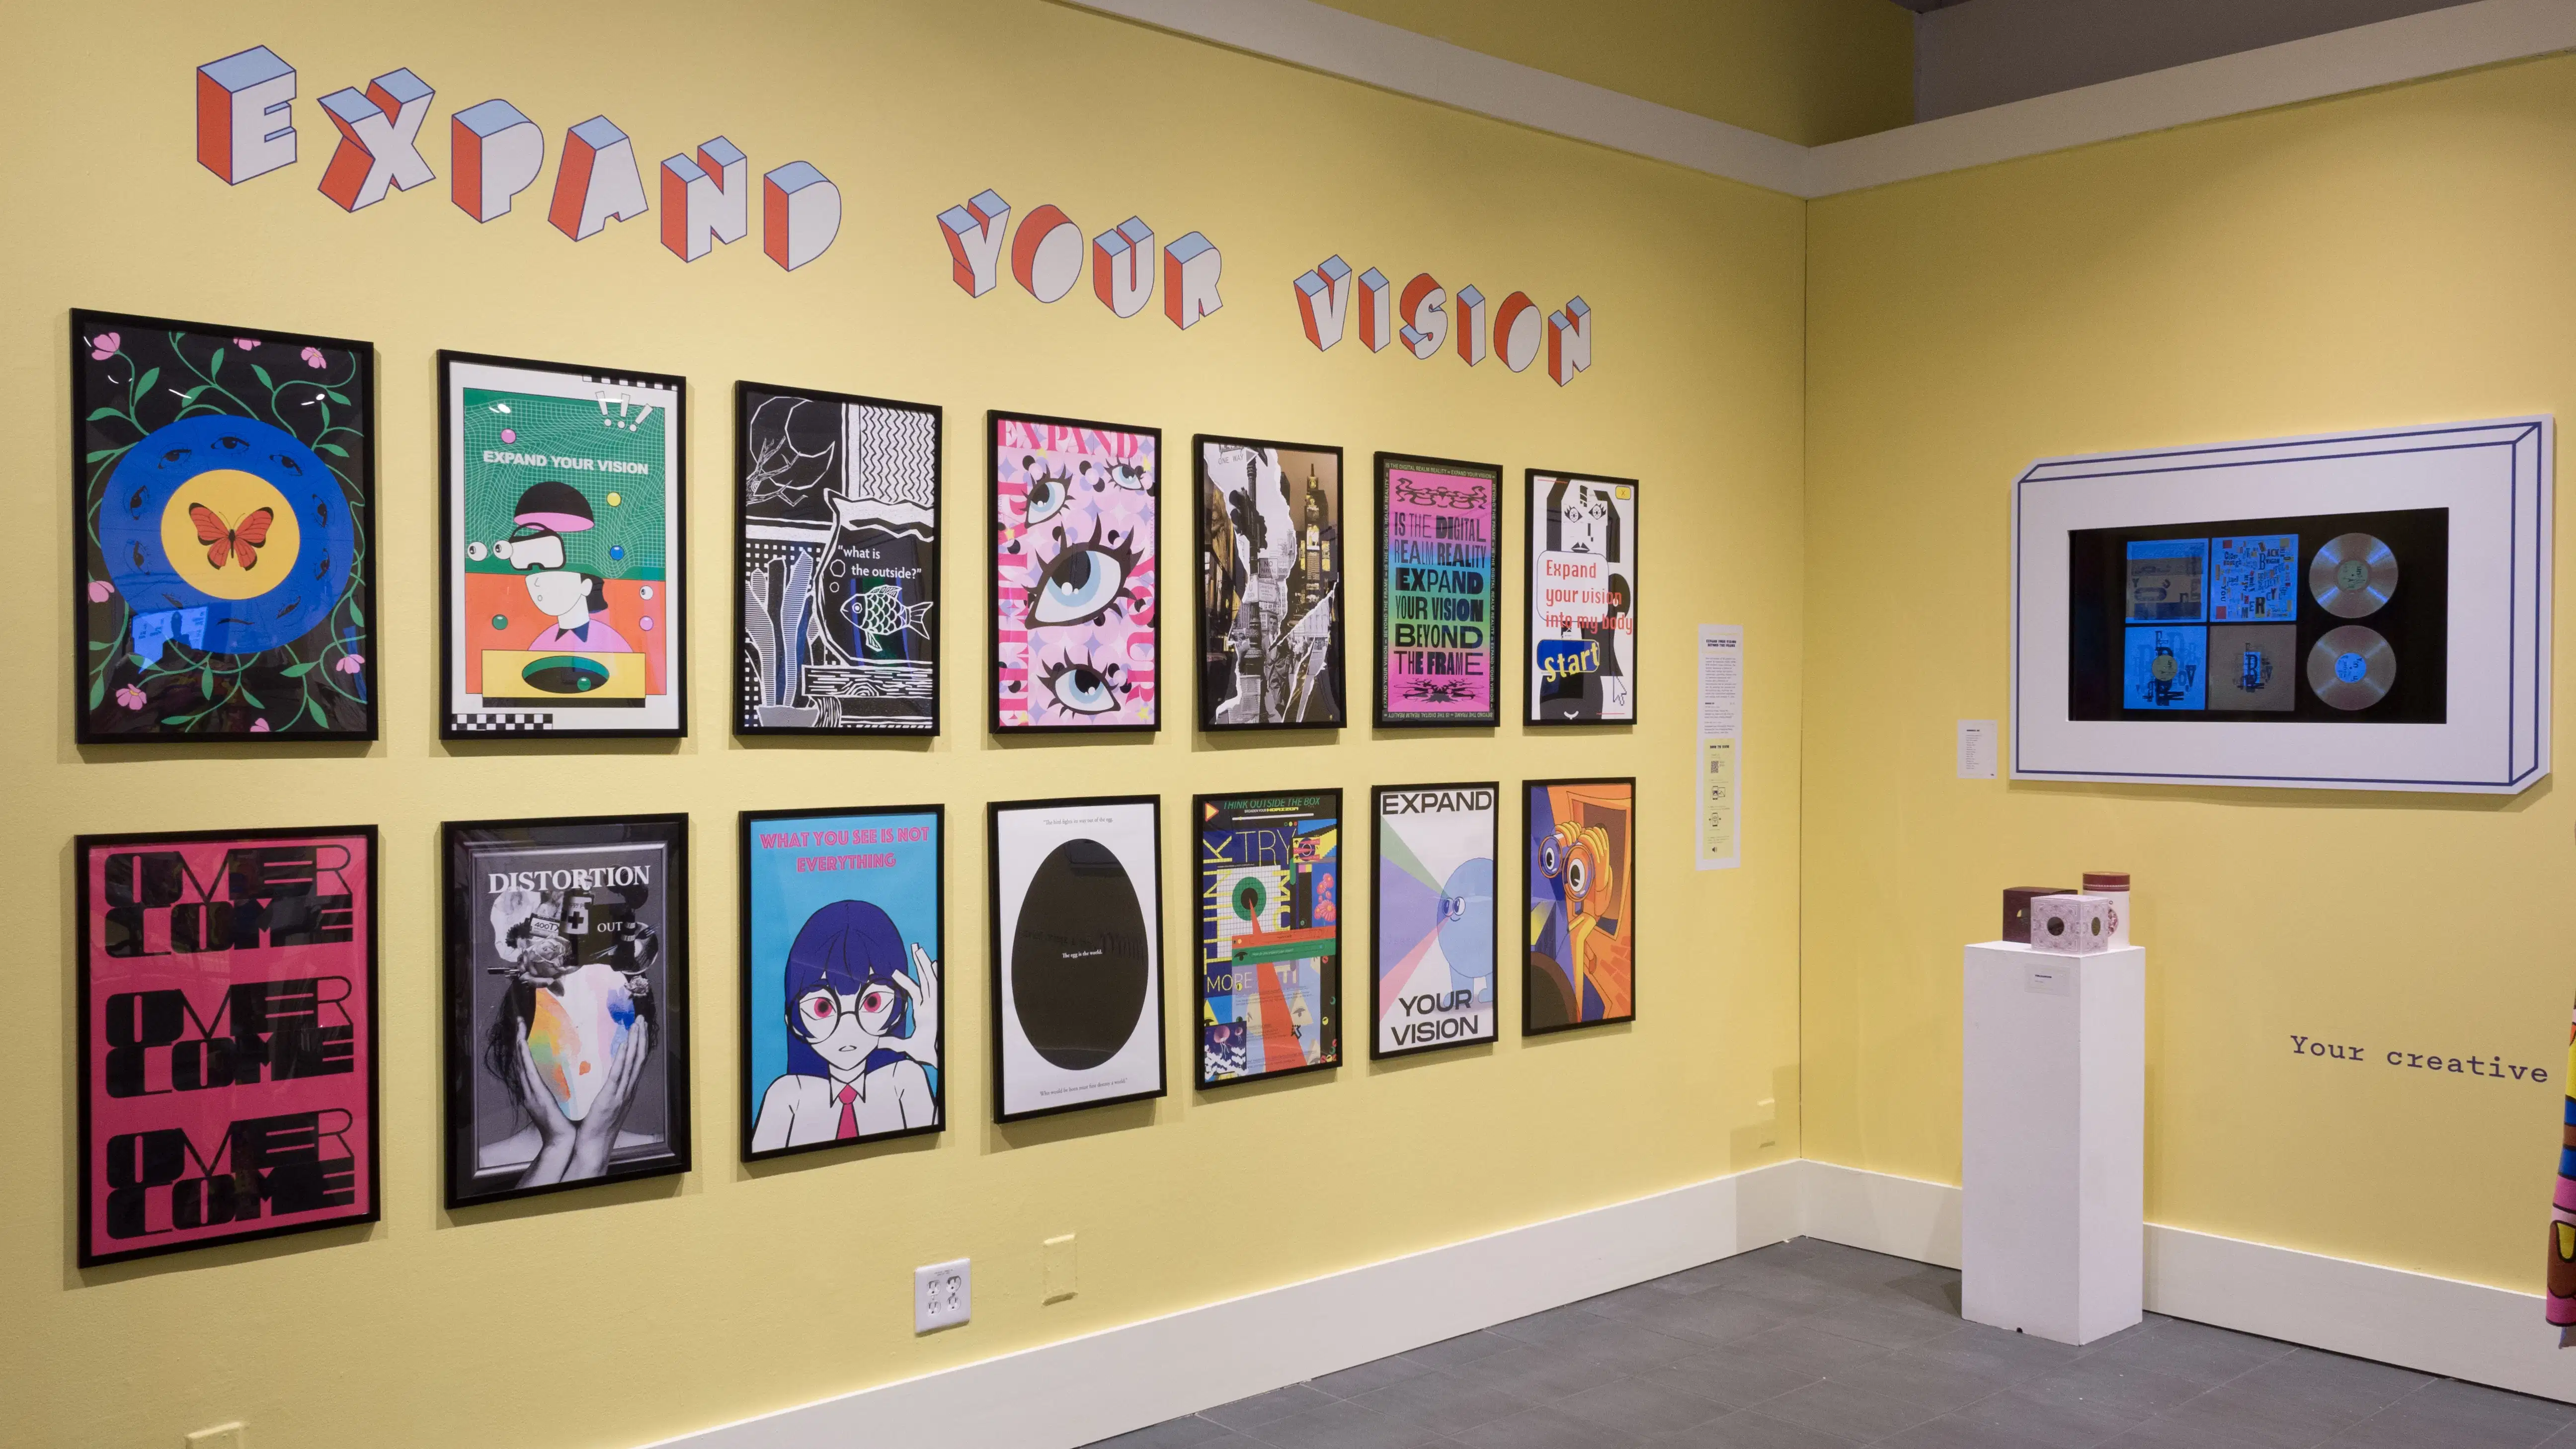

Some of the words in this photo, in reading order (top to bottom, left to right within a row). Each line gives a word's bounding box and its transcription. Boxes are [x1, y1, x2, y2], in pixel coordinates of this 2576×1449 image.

[197, 45, 841, 271] EXPAND
[937, 188, 1223, 330] YOUR
[1293, 254, 1591, 387] VISION
[998, 419, 1138, 458] EXPAND
[483, 451, 547, 467] EXPAND
[551, 456, 594, 471] YOUR
[597, 460, 648, 475] VISION
[1394, 512, 1406, 537] IS
[1409, 513, 1432, 538] THE
[1436, 515, 1486, 542] DIGITAL
[838, 545, 870, 559] "what
[872, 549, 881, 560] is
[1394, 539, 1434, 565] REALM
[1437, 542, 1486, 568] REALITY
[851, 564, 870, 576] the
[872, 568, 922, 579] outside?"
[1395, 567, 1484, 594] EXPAND
[1546, 560, 1597, 580] Expand
[1395, 595, 1428, 620] YOUR
[1432, 597, 1484, 622] VISION
[1546, 588, 1579, 607] your
[1582, 588, 1622, 605] vision
[1126, 555, 1154, 705] YOUR
[1395, 623, 1483, 649] BEYOND
[1546, 611, 1573, 629] into
[1577, 616, 1598, 635] my
[1602, 614, 1633, 636] body
[1394, 650, 1424, 675] THE
[1427, 651, 1483, 675] FRAME
[1224, 801, 1248, 809] THINK
[1250, 799, 1285, 808] OUTSIDE
[1288, 798, 1302, 806] THE
[1303, 797, 1320, 805] BOX
[1382, 791, 1492, 815] EXPAND
[759, 832, 809, 849] WHAT
[812, 830, 849, 846] YOU
[852, 829, 878, 845] SEE
[881, 828, 894, 843] IS
[897, 826, 930, 842] NOT
[1235, 828, 1296, 867] TRY
[105, 844, 352, 908] OVER
[797, 853, 896, 873] EVERYTHING
[488, 865, 651, 894] DISTORTION
[1203, 835, 1233, 975] THINK
[105, 894, 353, 958] COME
[597, 922, 623, 932] OUT
[105, 975, 353, 1047] OVER
[1399, 989, 1472, 1017] YOUR
[1391, 1015, 1478, 1046] VISION
[105, 1025, 354, 1099] COME
[2290, 1035, 2364, 1061] Your
[2387, 1050, 2548, 1083] creative
[107, 1108, 354, 1189] OVER
[107, 1156, 355, 1240] COME
